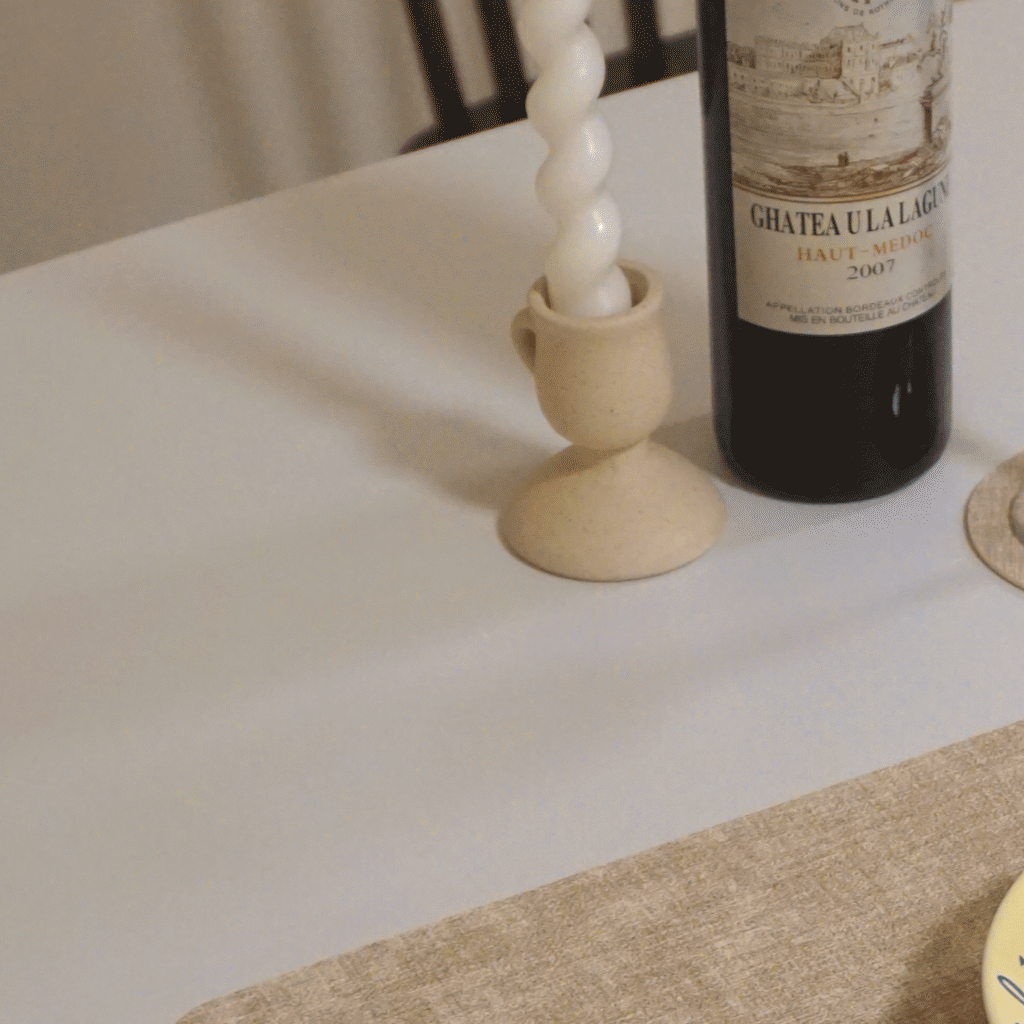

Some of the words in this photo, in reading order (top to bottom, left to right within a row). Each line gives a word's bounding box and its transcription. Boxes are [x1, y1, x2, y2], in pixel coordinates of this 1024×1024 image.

[846, 258, 897, 281] 2007
[765, 300, 842, 315] APPELLATION
[845, 296, 903, 314] BORDEAUX
[811, 316, 826, 325] EN
[829, 311, 885, 325] BOUTEILLE
